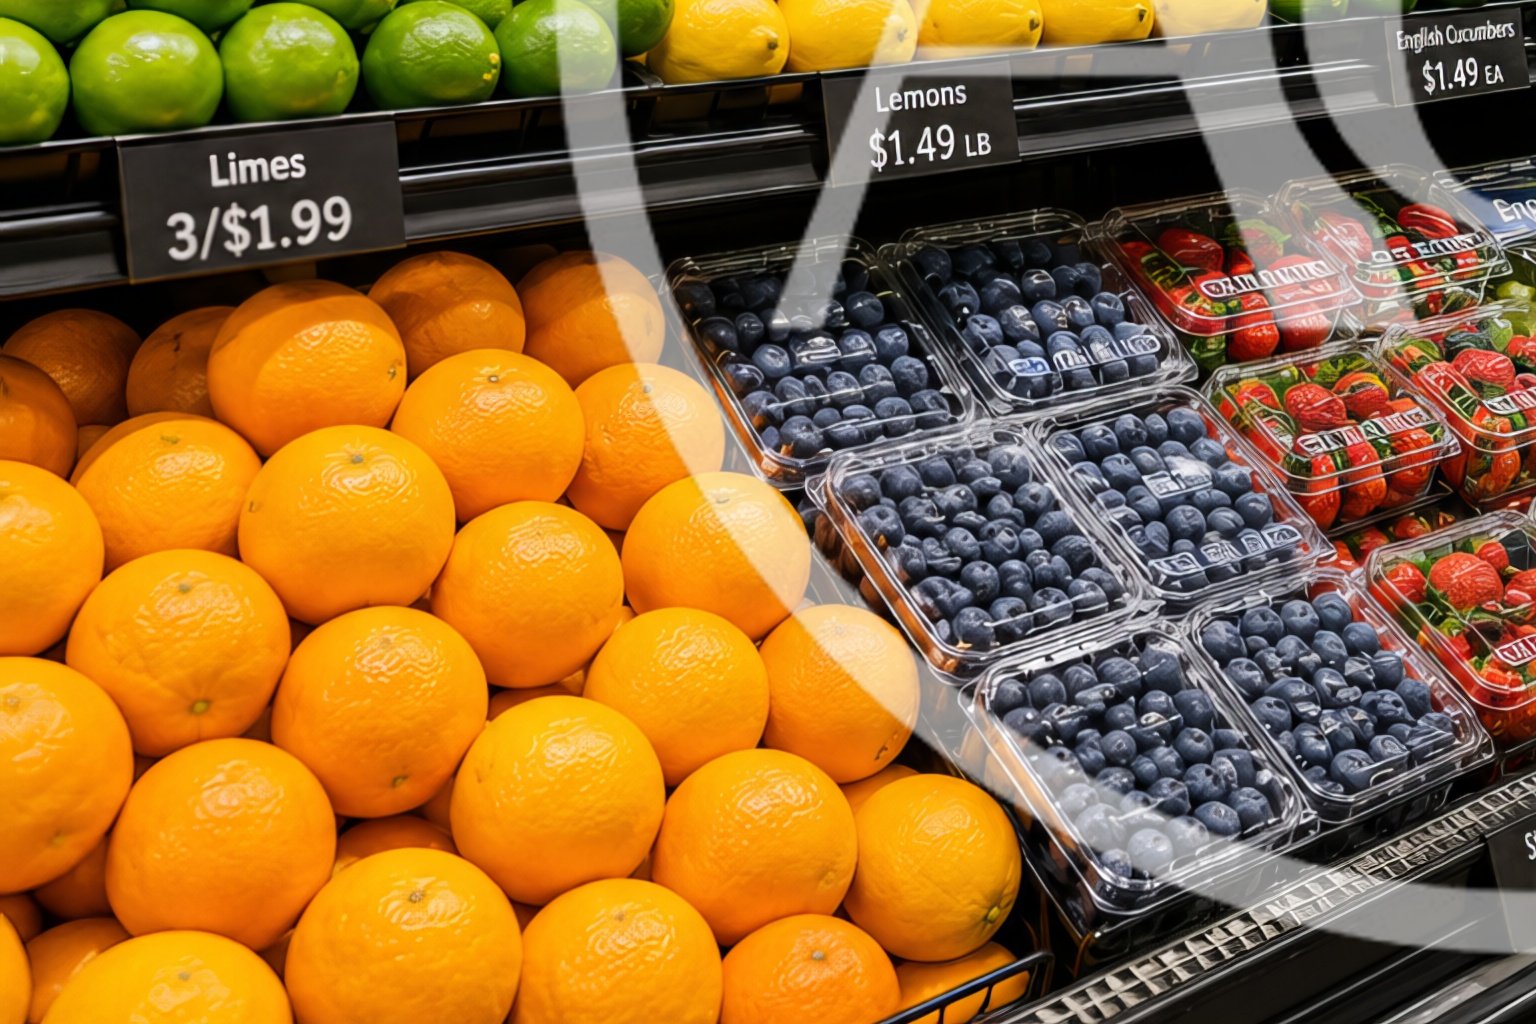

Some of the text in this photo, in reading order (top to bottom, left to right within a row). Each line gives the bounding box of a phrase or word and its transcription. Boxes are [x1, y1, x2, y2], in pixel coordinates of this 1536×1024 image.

[1422, 57, 1505, 96] $1.49 EA
[874, 84, 968, 113] Lemons
[868, 124, 992, 173] $1.49 LB
[209, 151, 306, 188] Limes
[166, 195, 352, 262] 3/$1.99
